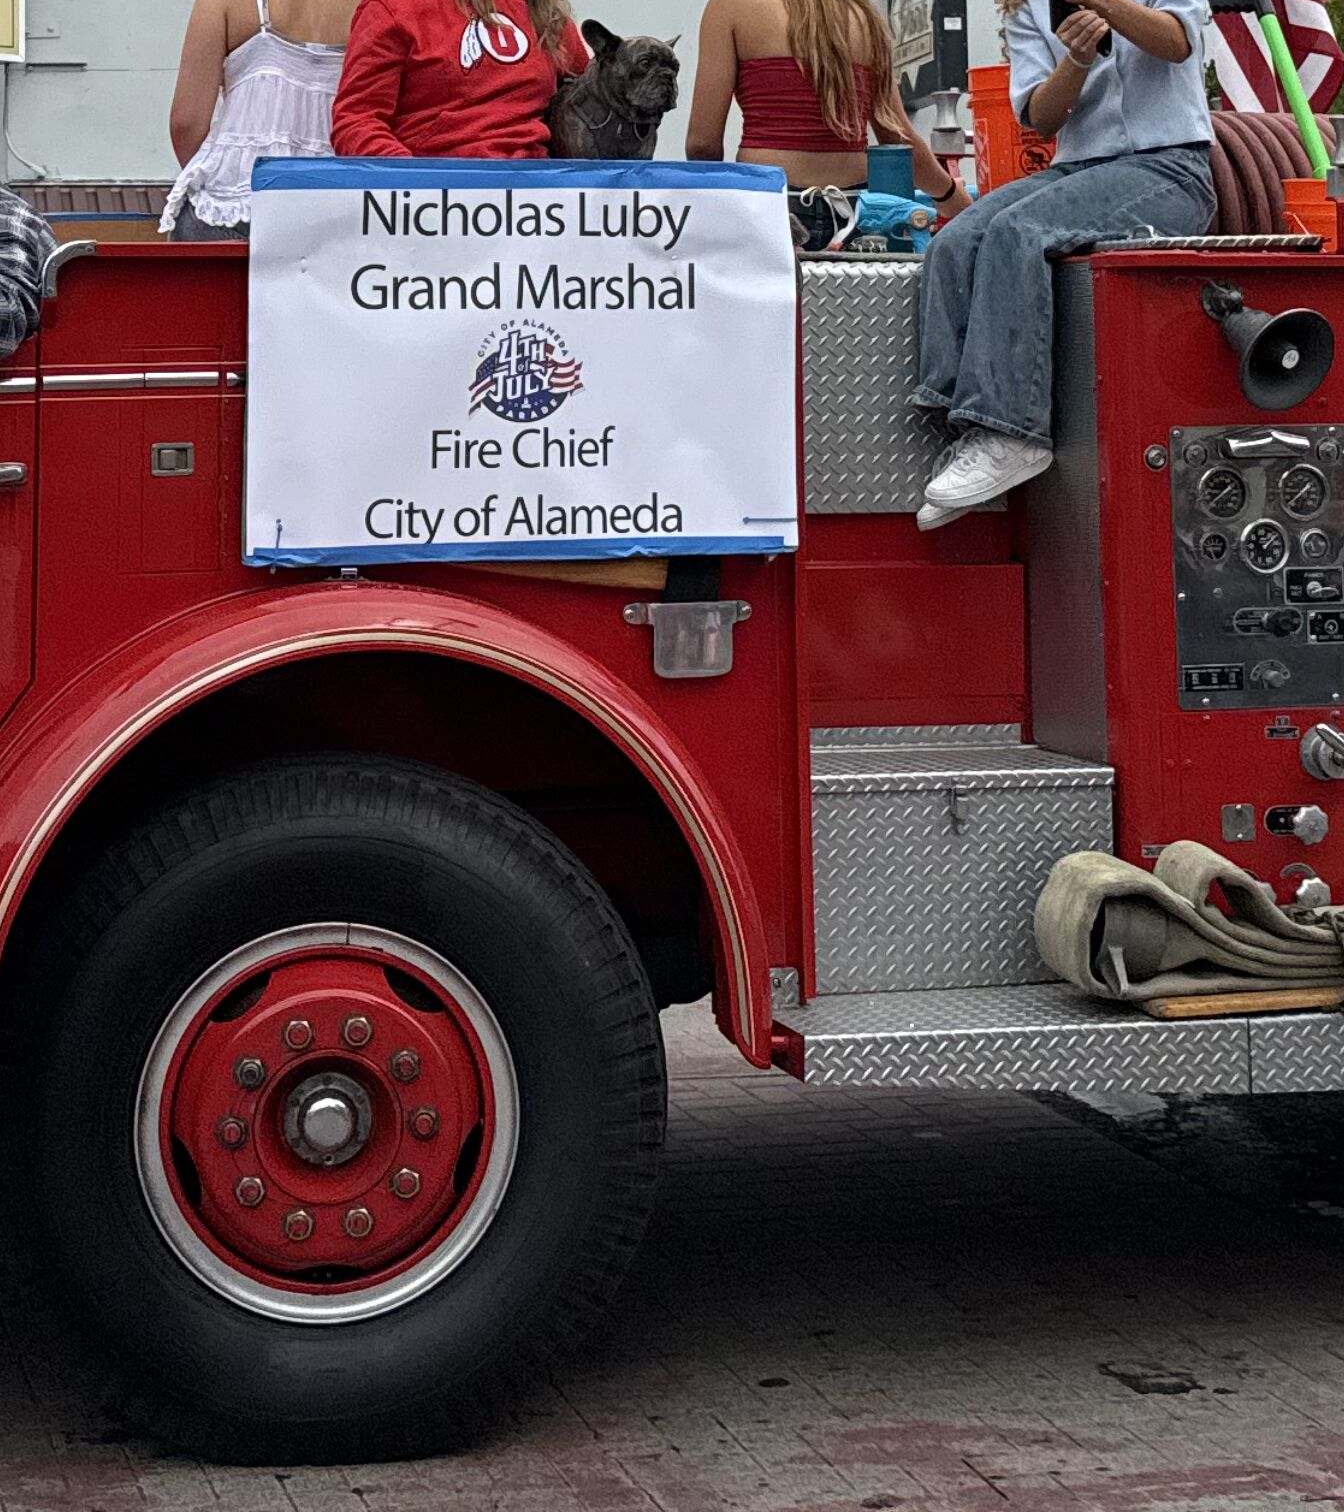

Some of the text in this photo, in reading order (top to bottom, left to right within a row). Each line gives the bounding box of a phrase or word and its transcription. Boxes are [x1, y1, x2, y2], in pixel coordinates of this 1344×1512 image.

[362, 189, 692, 252] Nicholas Luby
[350, 262, 696, 310] Grand Marshal
[477, 318, 569, 358] CITY OF ALAMEDA
[498, 329, 547, 375] 4TH
[487, 366, 557, 403] JULY
[431, 425, 616, 469] Fire Chief
[364, 492, 683, 545] City of Alameda
